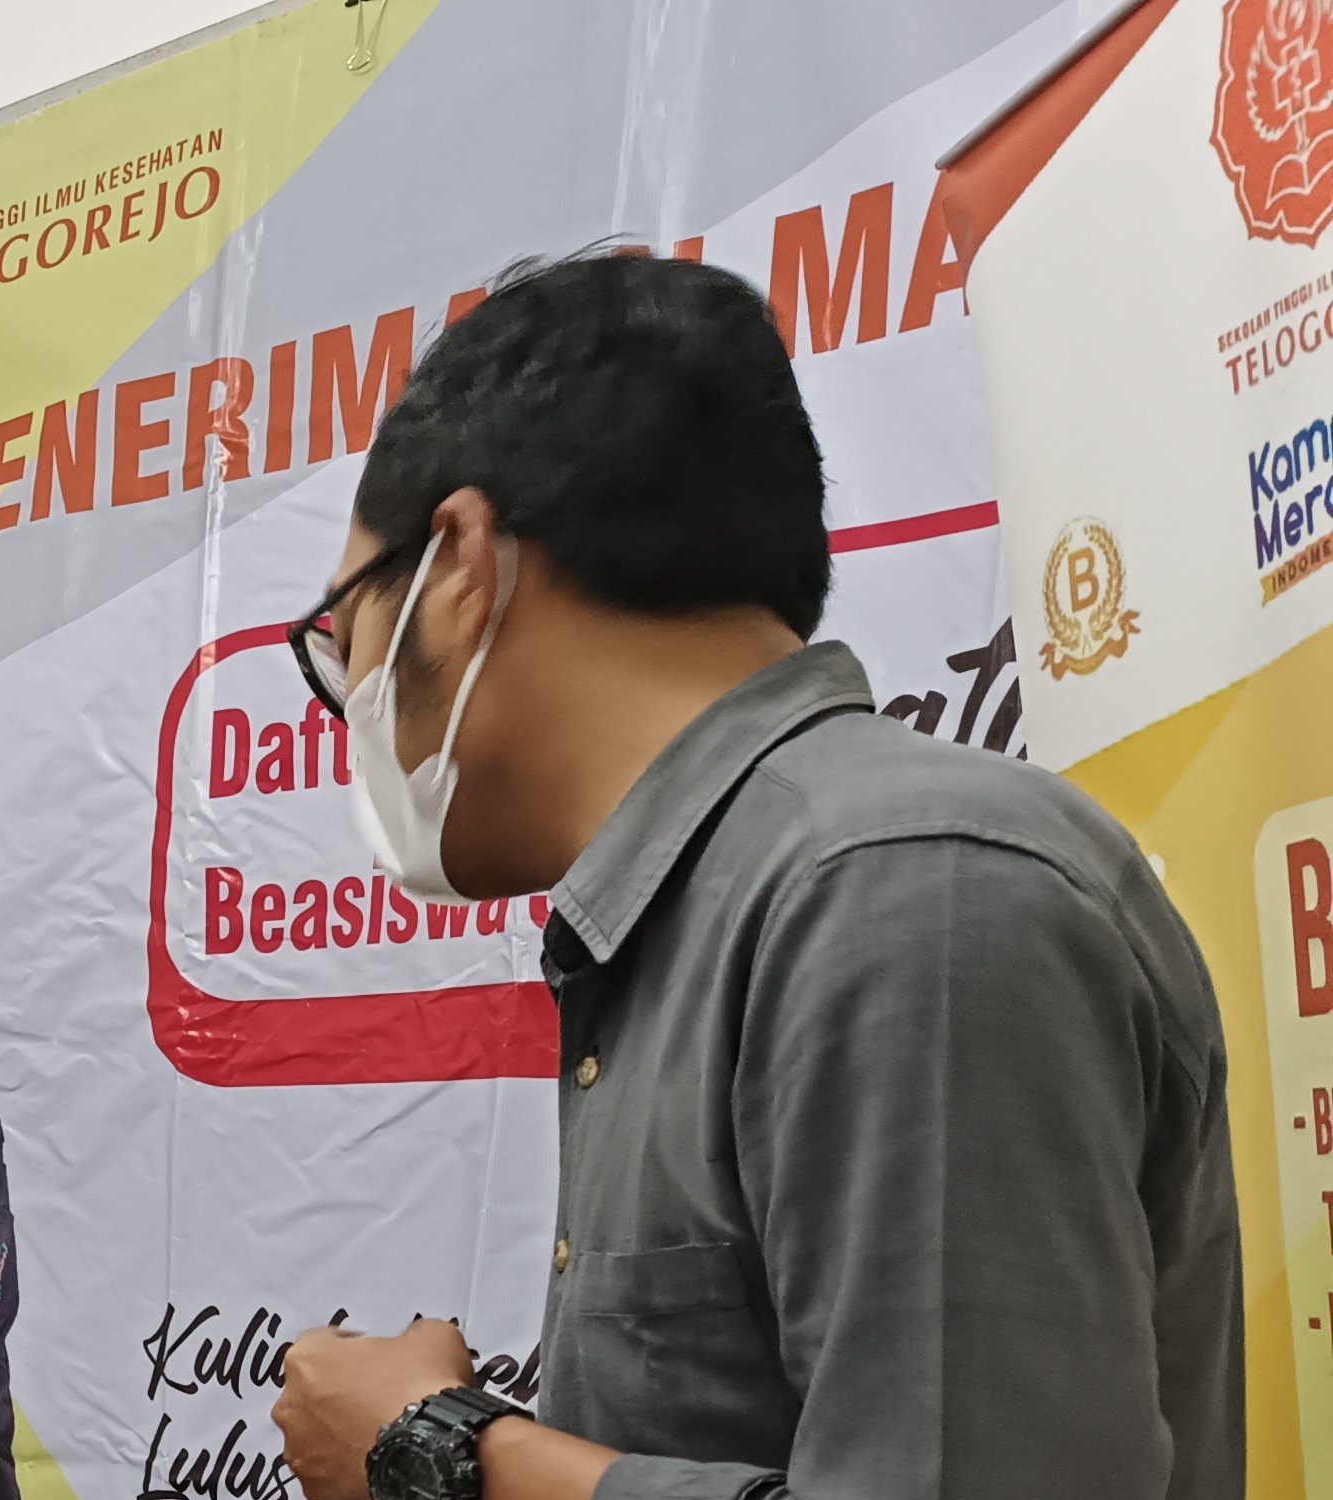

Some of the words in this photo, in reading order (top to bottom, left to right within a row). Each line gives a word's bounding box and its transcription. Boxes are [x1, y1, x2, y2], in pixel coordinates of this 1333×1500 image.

[34, 179, 87, 218] ILMU
[94, 128, 224, 196] KESEHATAN
[1218, 307, 1271, 353] SEKOLAH
[1273, 282, 1313, 320] TINGGI
[1248, 415, 1333, 512] Kam
[1067, 545, 1100, 614] B
